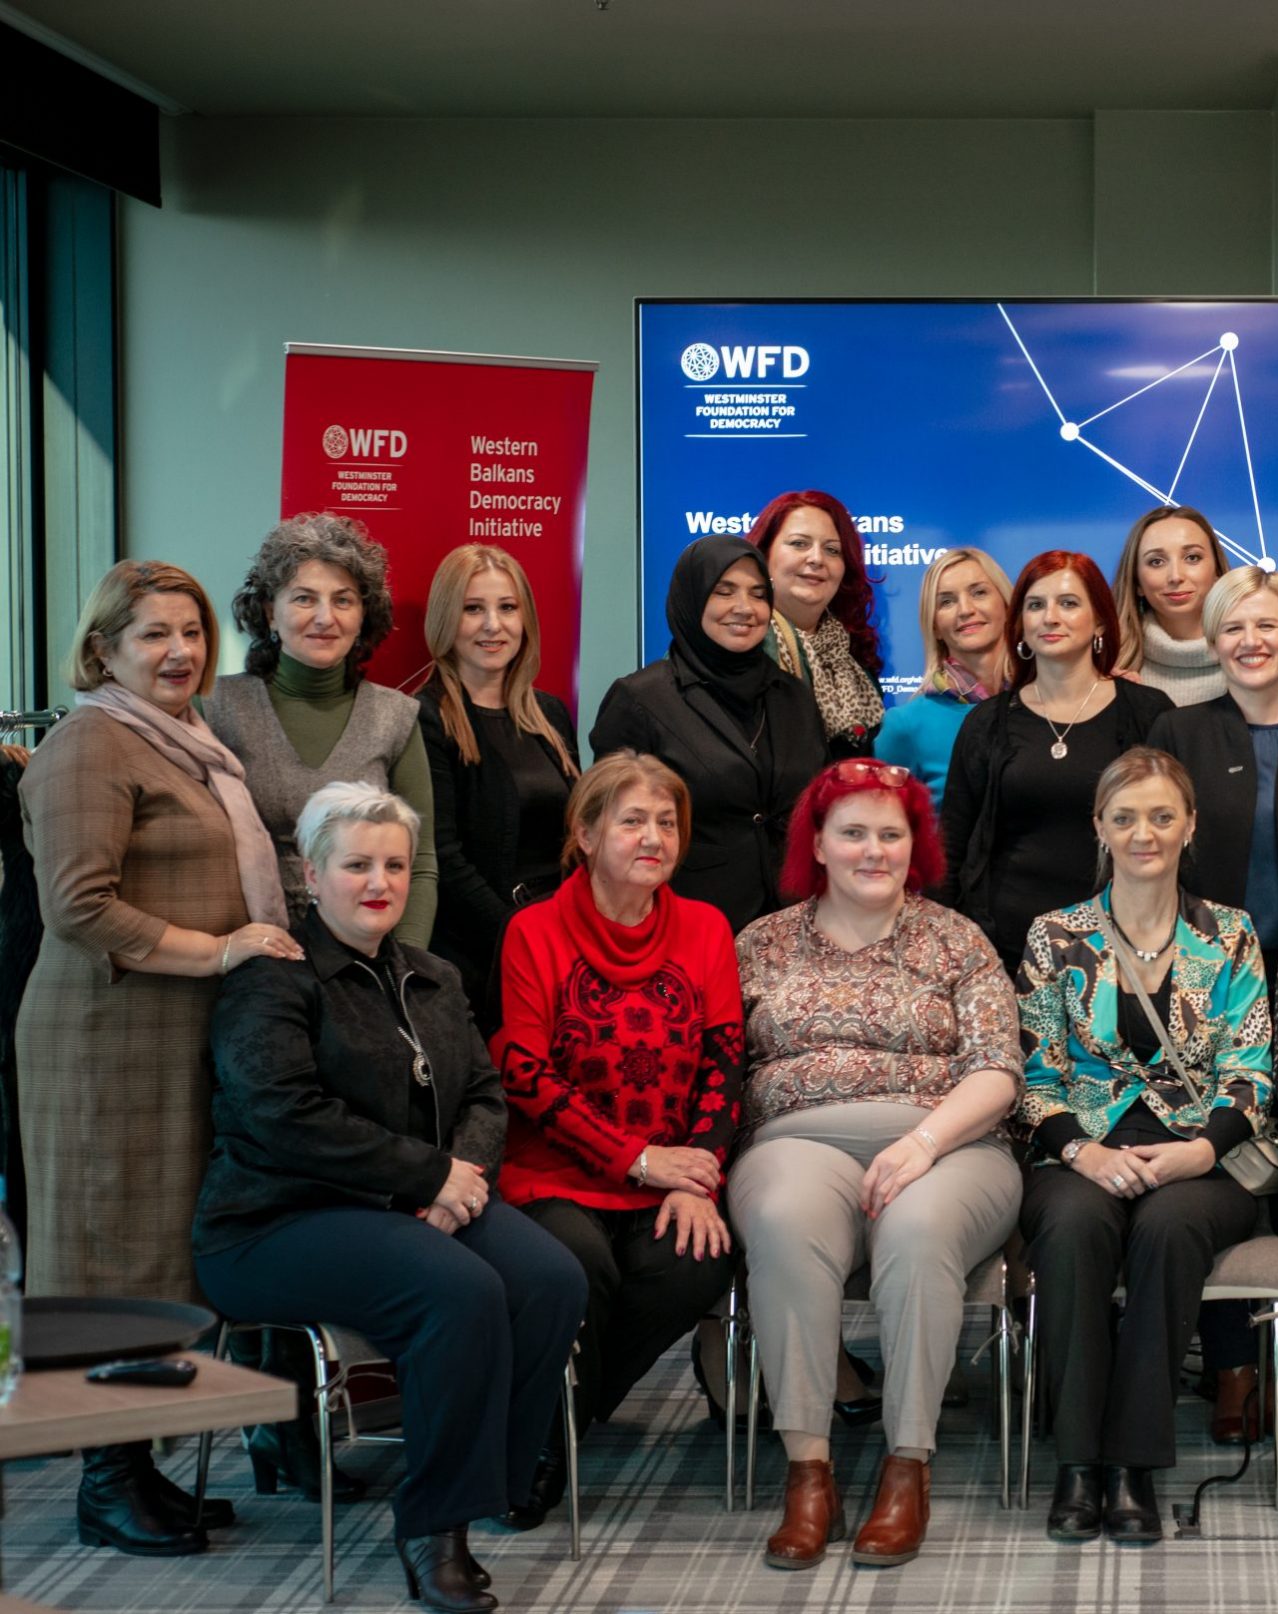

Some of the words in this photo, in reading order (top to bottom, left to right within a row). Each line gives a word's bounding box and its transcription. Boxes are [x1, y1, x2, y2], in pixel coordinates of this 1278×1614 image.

[720, 345, 810, 378] WFD
[704, 393, 787, 404] WESTMINSTER
[695, 406, 769, 416] FOUNDATION
[771, 406, 796, 416] FOR
[709, 418, 782, 429] DEMOCRACY
[349, 428, 408, 458] WFD
[470, 435, 538, 456] Western
[338, 471, 391, 480] WESTMINSTER
[469, 463, 535, 484] Balkans
[332, 482, 380, 491] FOUNDATION
[382, 483, 397, 492] FOR
[341, 493, 388, 502] DEMOCRACY
[469, 490, 562, 515] Democracy
[468, 517, 543, 538] Initiative
